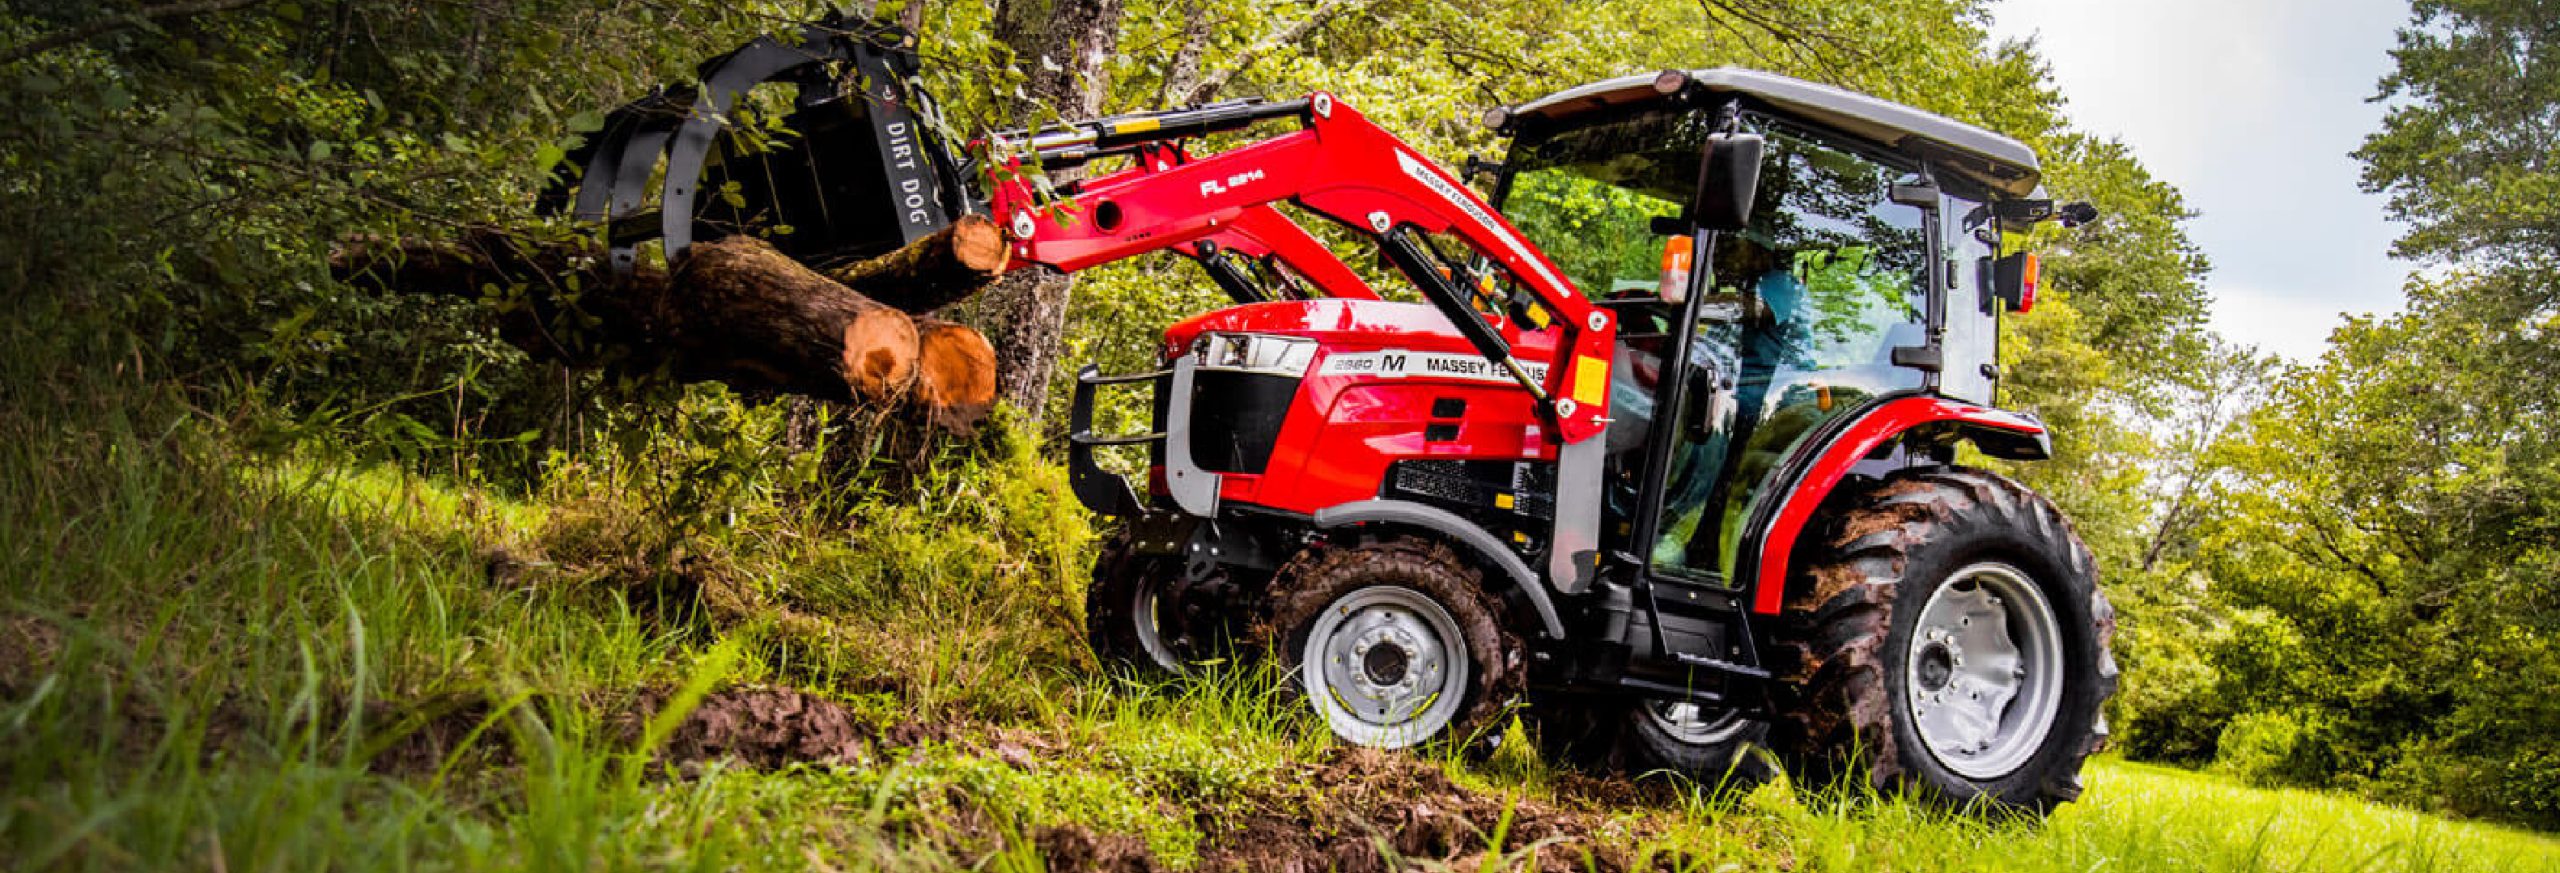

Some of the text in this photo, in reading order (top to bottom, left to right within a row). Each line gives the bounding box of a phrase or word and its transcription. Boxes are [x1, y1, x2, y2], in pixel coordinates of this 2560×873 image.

[887, 121, 931, 224] DIRT DOG
[1200, 180, 1226, 198] FL
[1415, 166, 1496, 230] MASSEY FERGUSON
[1382, 354, 1406, 371] M
[1427, 357, 1486, 374] MASSEY
